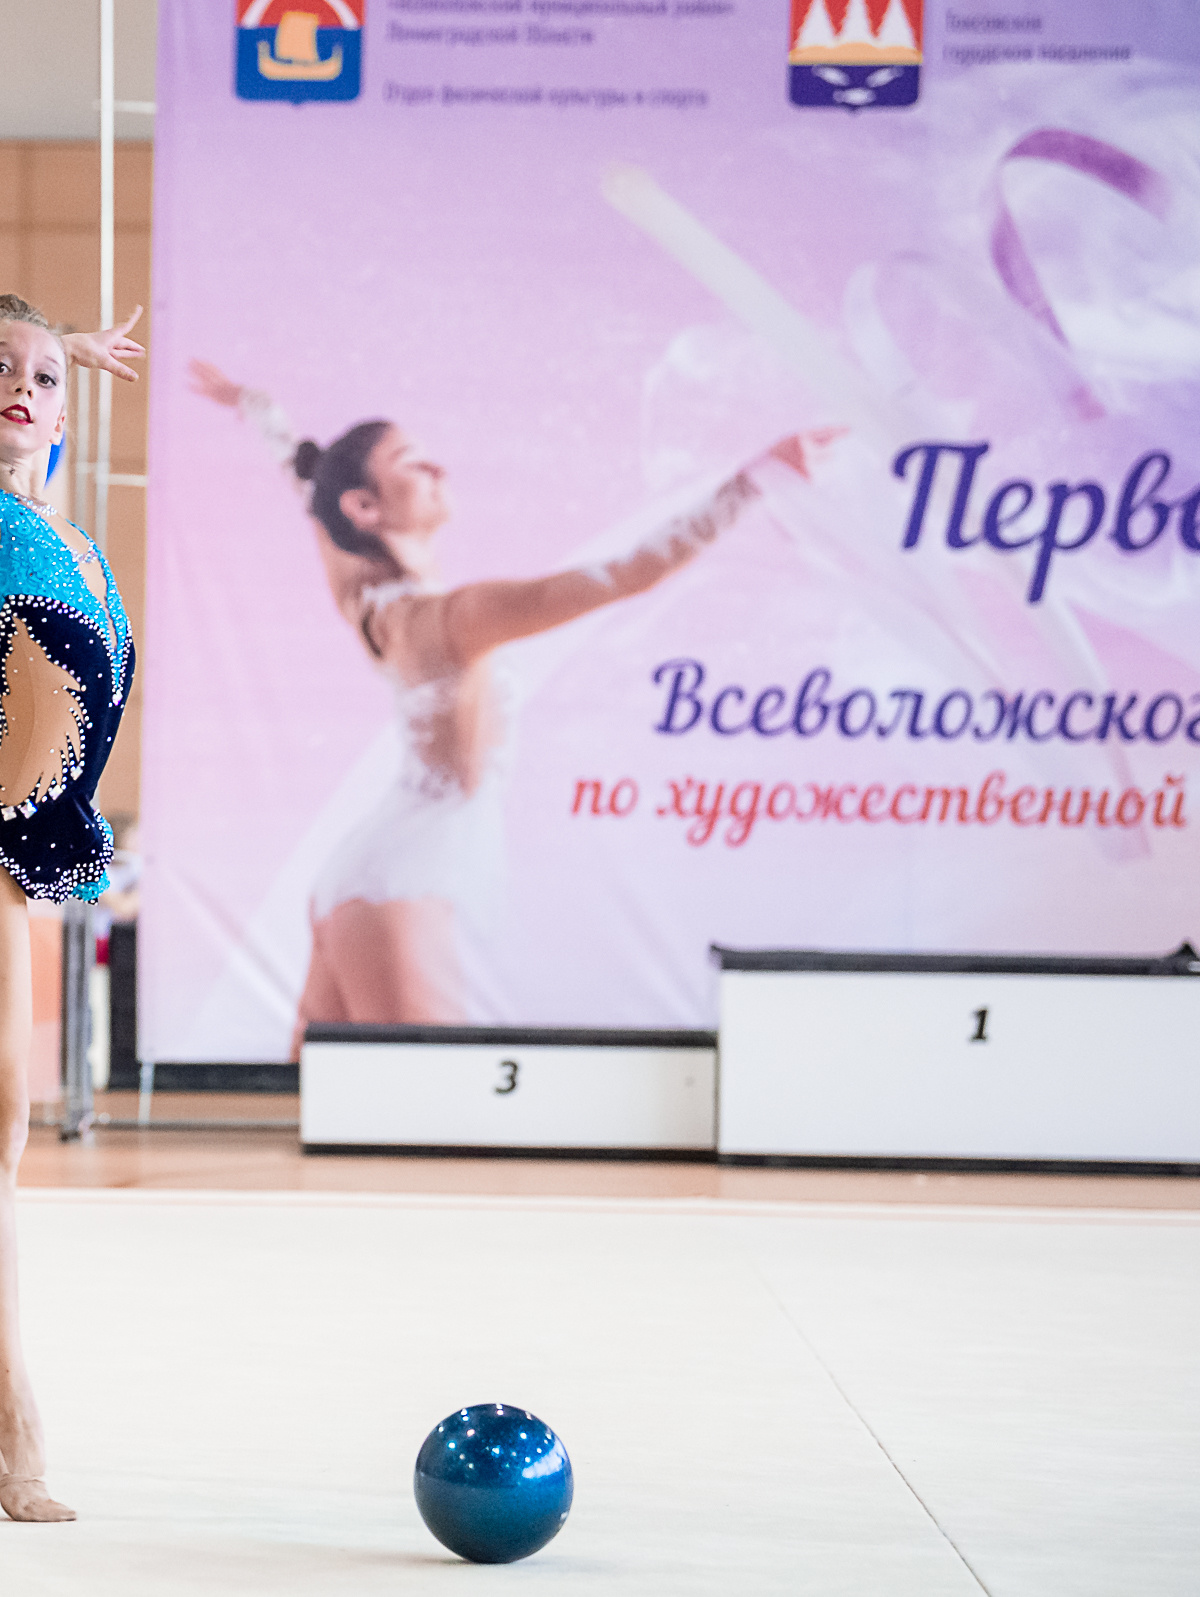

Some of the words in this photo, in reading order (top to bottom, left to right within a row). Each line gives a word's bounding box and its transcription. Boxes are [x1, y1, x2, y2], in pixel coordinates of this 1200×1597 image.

[571, 777, 639, 818] по
[655, 768, 1185, 848] художественной
[969, 1008, 988, 1042] 1
[494, 1060, 518, 1095] 3
